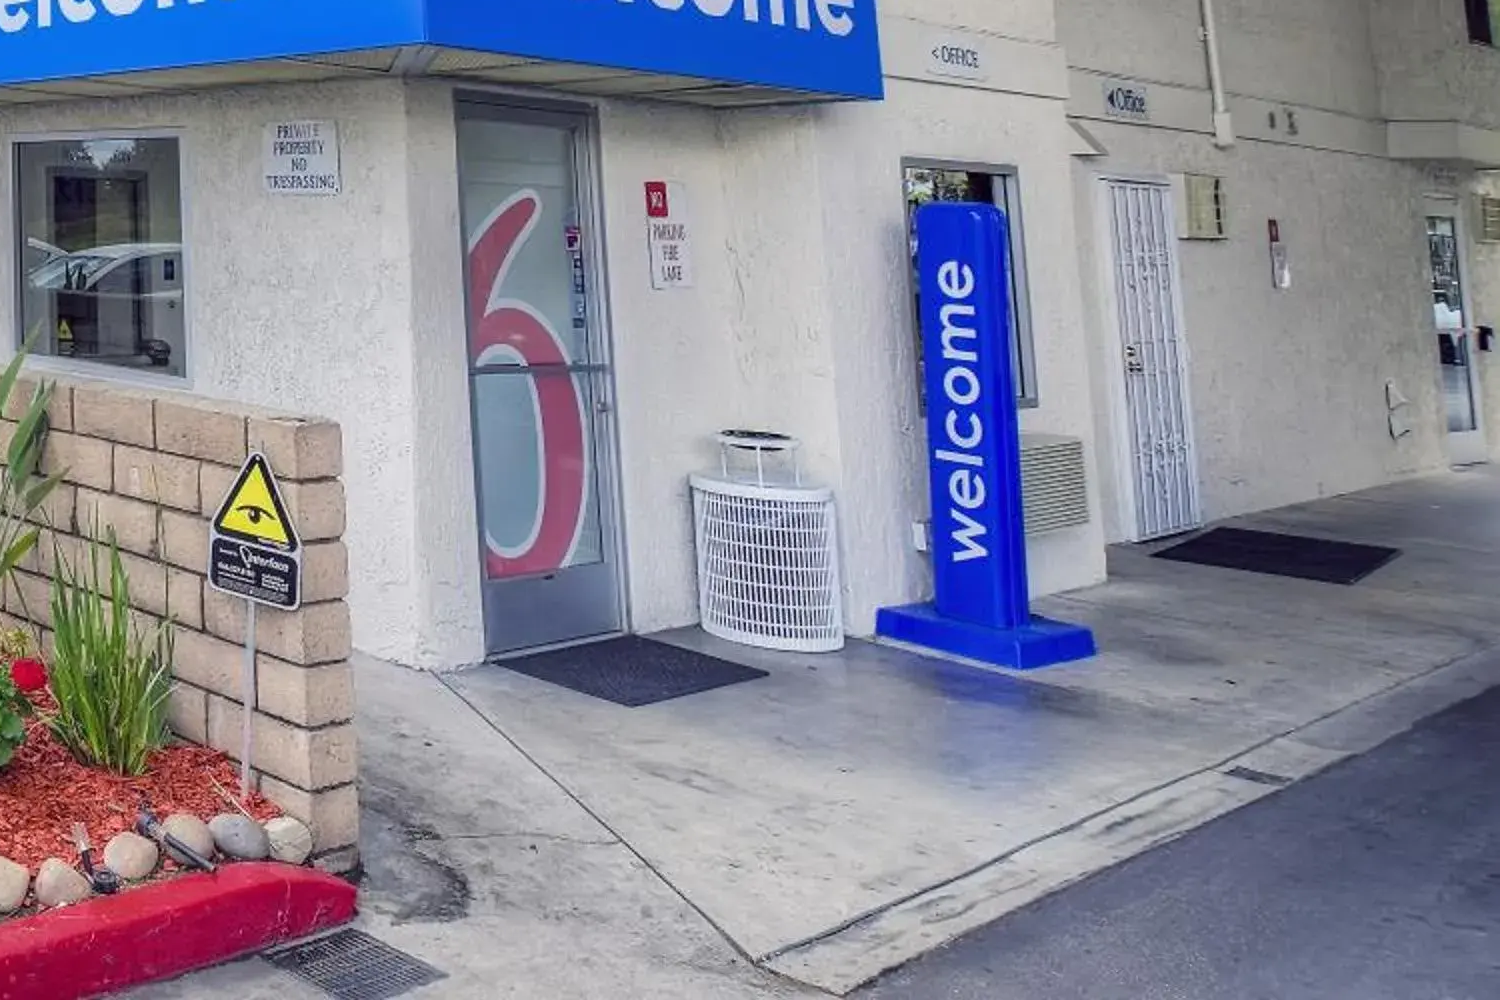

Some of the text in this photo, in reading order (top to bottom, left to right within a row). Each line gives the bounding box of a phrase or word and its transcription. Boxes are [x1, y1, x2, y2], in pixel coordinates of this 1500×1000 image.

[941, 45, 979, 69] OFFICE
[1115, 87, 1145, 113] Office
[277, 123, 320, 139] PRIVATE
[273, 140, 325, 156] PROPERTY
[291, 157, 307, 172] NO
[266, 175, 336, 189] TRESPASSING
[935, 260, 988, 562] welcome
